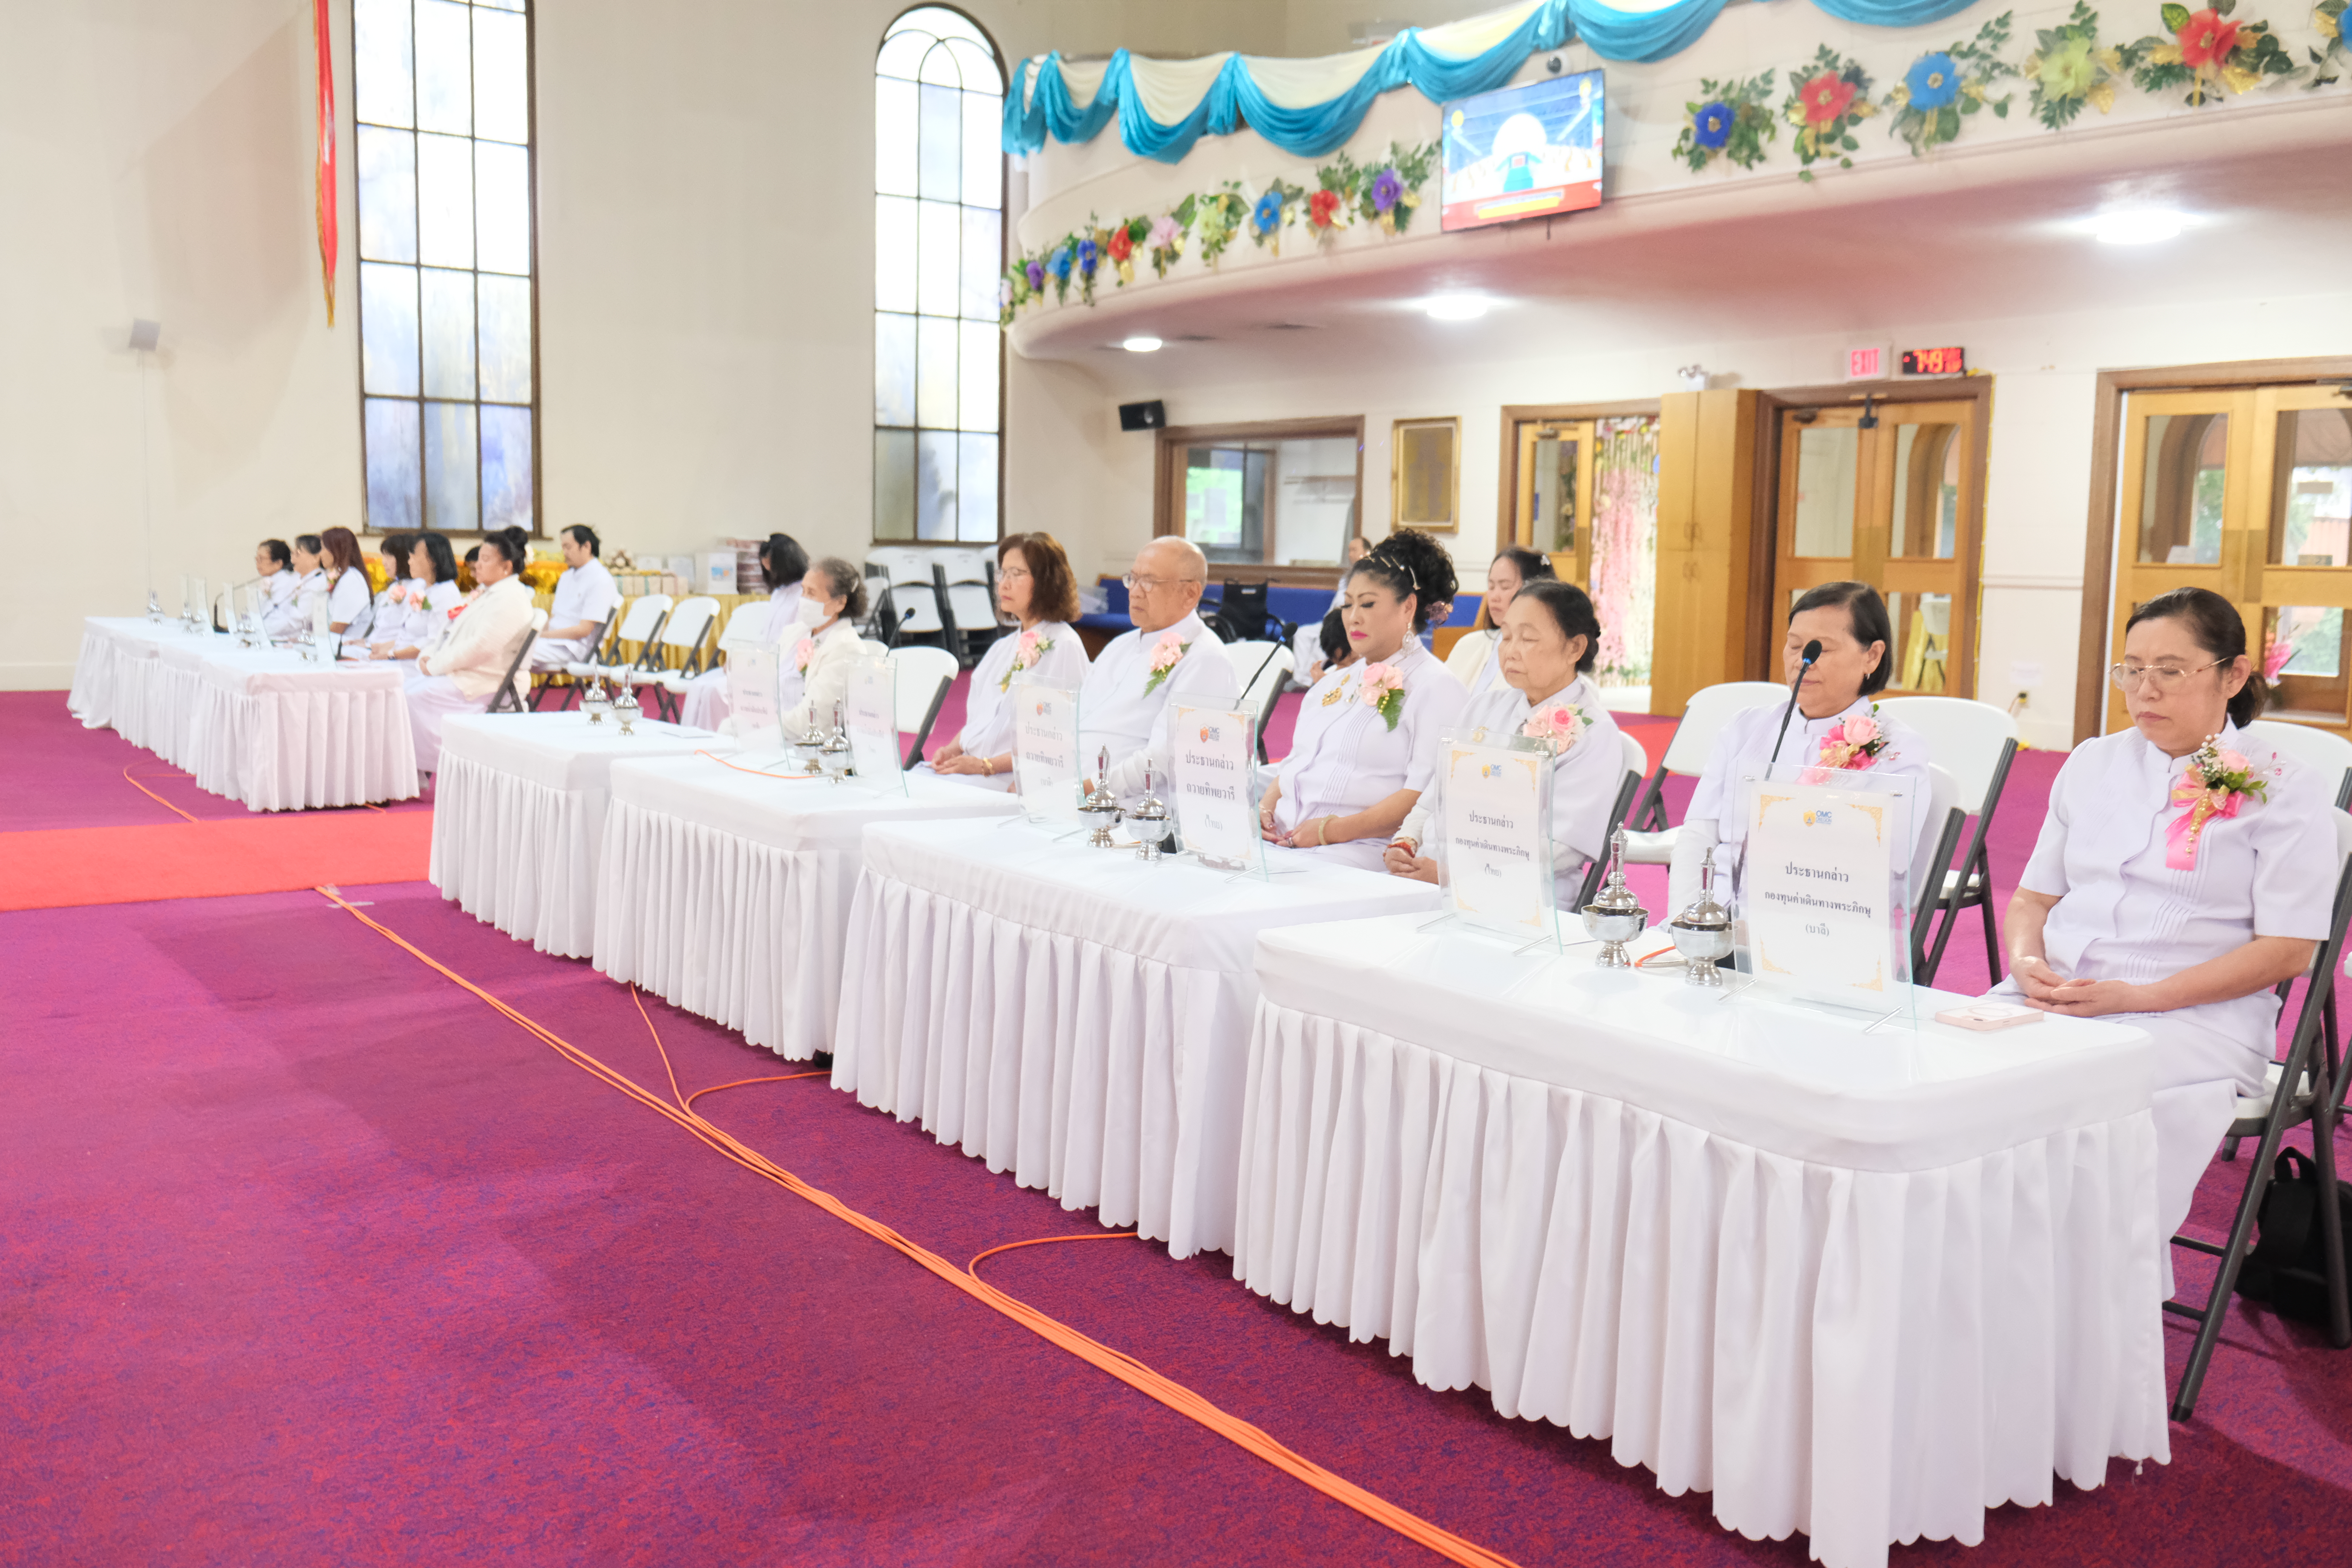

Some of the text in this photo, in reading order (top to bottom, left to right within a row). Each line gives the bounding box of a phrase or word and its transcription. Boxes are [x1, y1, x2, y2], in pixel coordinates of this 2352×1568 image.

[1025, 721, 1063, 741] ประธานกล่าว
[1026, 751, 1064, 768] ถวายทิพยวารี
[1186, 750, 1233, 770] ประธานกล่าว
[1187, 782, 1235, 800] ถวายทิพยวารี
[1469, 810, 1513, 828] ประธานกล่าว
[1816, 810, 1832, 818] OMC
[1455, 837, 1530, 861] กองทุนค่าเดินทางพระภิกษุ
[1785, 862, 1849, 882] ประธานกล่าว
[1765, 891, 1871, 918] กองทุนค่าเดินทางพระภิกษุ
[1805, 923, 1830, 937] (บาลี)
